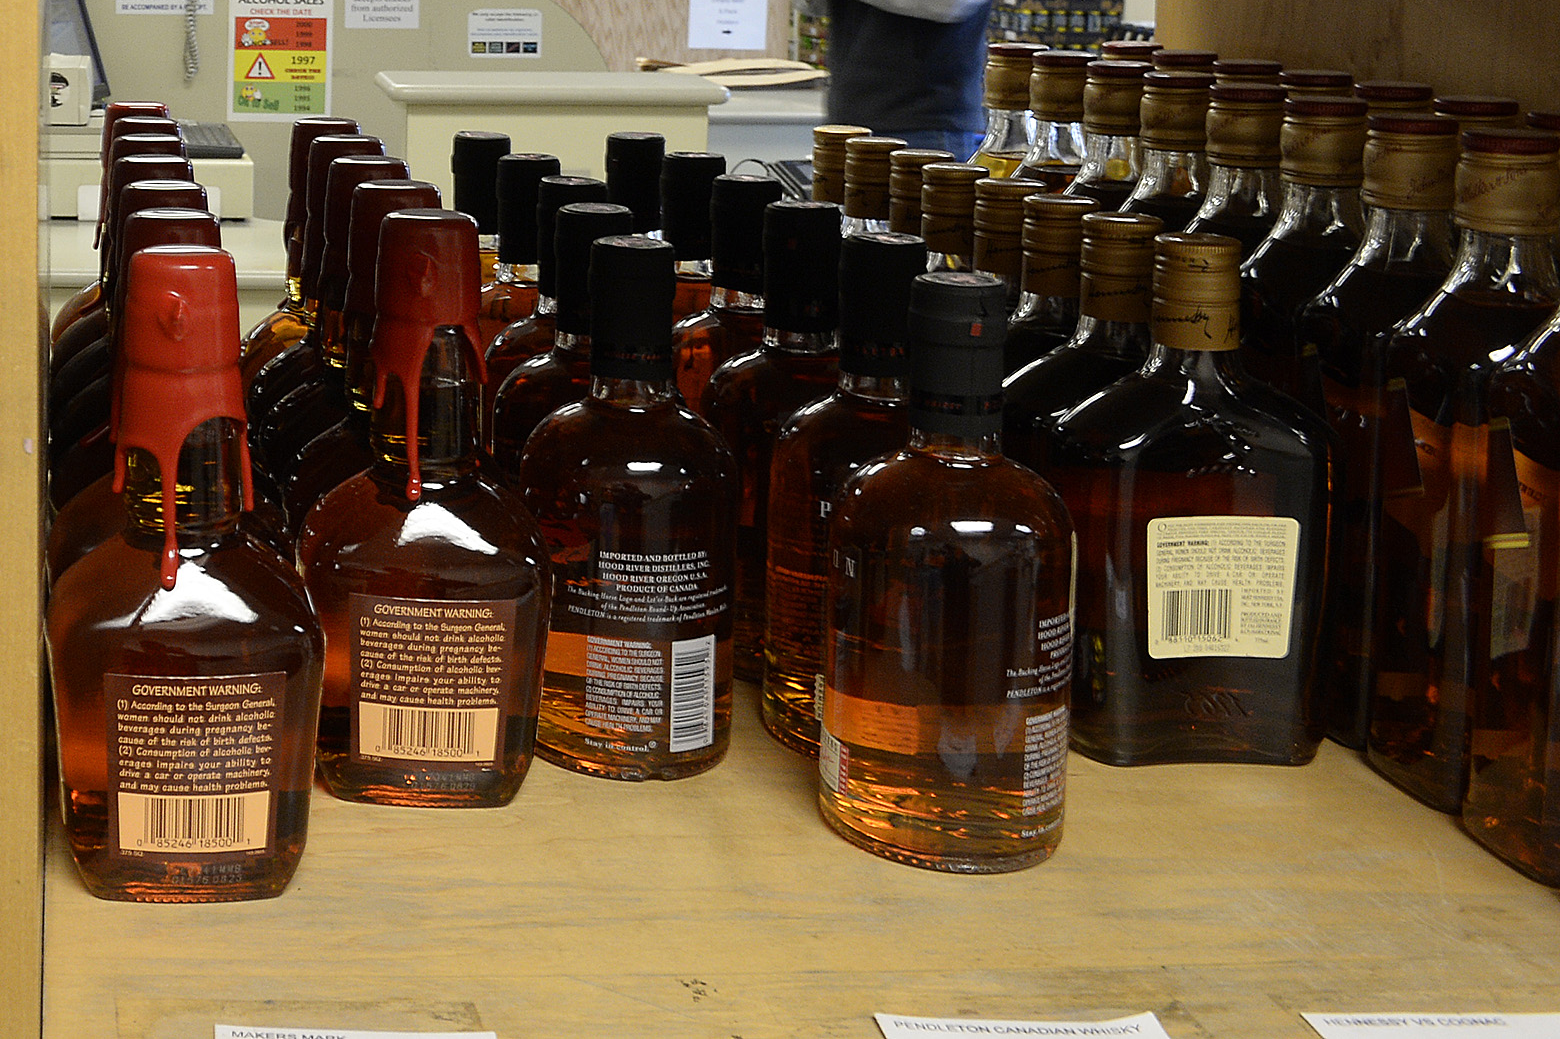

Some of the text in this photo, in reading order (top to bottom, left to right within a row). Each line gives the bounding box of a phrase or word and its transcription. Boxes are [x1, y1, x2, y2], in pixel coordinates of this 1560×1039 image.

[351, 4, 414, 12] from authorized
[291, 56, 315, 65] 1997
[599, 551, 641, 562] IMPORTED
[644, 553, 661, 562] AND
[663, 552, 697, 562] BOTTLED
[598, 561, 710, 572] HOOD RIVER DISTILLERS, INC.
[602, 573, 629, 582] HOOD
[630, 574, 654, 583] RIVER
[656, 575, 689, 583] OREGON
[616, 584, 698, 593] PRODUCT OF CANADA
[132, 683, 263, 697] GOVERNMENT WARNING:
[117, 699, 128, 710] (1)
[131, 701, 173, 713] According
[175, 703, 186, 711] to
[188, 703, 203, 711] the
[205, 701, 240, 712] Surgeon
[117, 710, 275, 723] women should not drink alcoholic
[118, 722, 272, 738] beverages during pregnancy be-
[118, 737, 144, 745] cause
[161, 738, 176, 746] the
[180, 738, 196, 746] risk
[200, 738, 211, 746] of
[213, 737, 235, 745] birth
[238, 735, 272, 744] defects.
[118, 745, 272, 759] (2) Consumption of alcoholic bev-
[393, 747, 463, 757] 85246 18500
[157, 838, 232, 848] 85246 18500
[1323, 1017, 1507, 1026] HENNESSY VS COGNAC
[893, 1020, 1141, 1035] PENDLETON CANADIAN WHISKY
